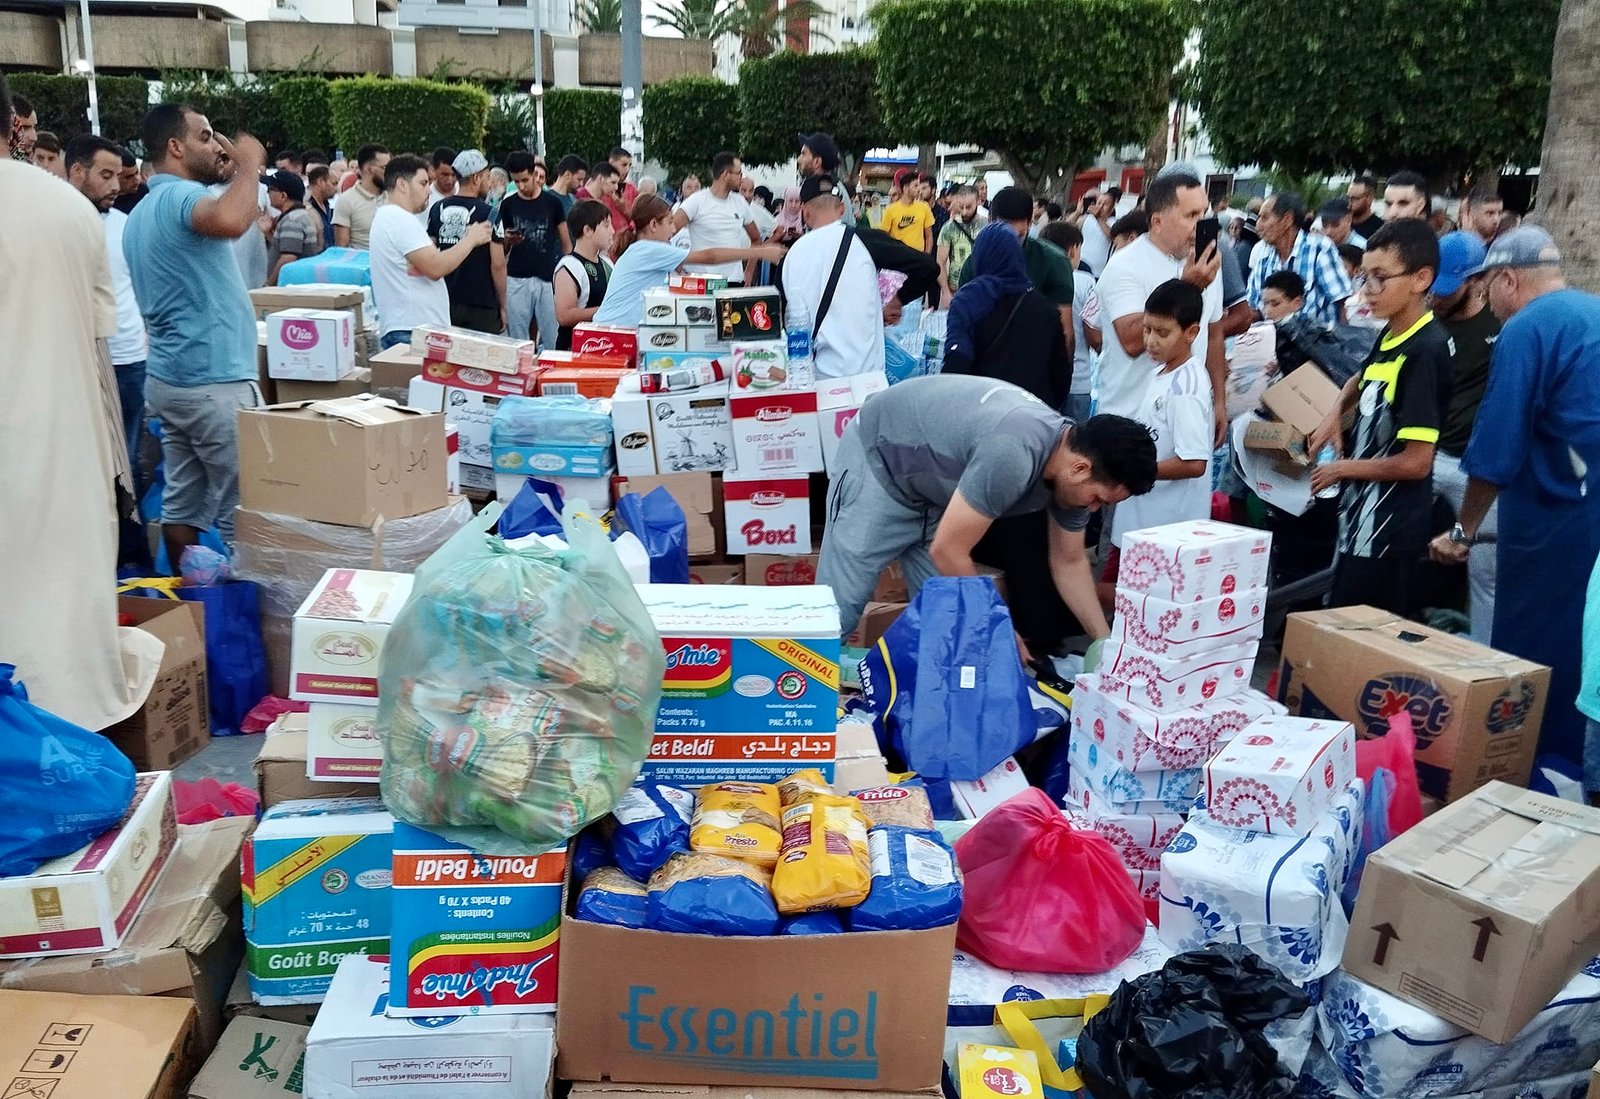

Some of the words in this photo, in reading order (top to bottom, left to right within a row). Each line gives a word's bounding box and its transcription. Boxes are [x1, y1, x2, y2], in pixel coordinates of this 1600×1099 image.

[741, 519, 796, 546] Boxi
[778, 641, 833, 679] ORIGINAL
[660, 707, 693, 716] Contents
[656, 718, 679, 726] Packs
[700, 719, 706, 727] g
[671, 739, 714, 756] Beldi
[741, 735, 787, 758] بلدي
[791, 735, 831, 757] دجاج
[863, 788, 902, 800] Frida
[725, 835, 757, 846] Presto
[415, 859, 468, 881] Beldi
[471, 858, 538, 879] Poulet
[439, 896, 446, 905] g
[448, 897, 460, 906] 70
[461, 897, 469, 906] X
[470, 896, 498, 906] Packs
[500, 896, 512, 905] 40
[453, 909, 494, 919] Contents
[310, 922, 323, 932] 70
[356, 919, 369, 929] 48
[439, 933, 495, 942] Instantanées
[497, 932, 531, 940] Nouilles
[268, 951, 313, 970] Goût
[618, 984, 878, 1057] Essentiel
